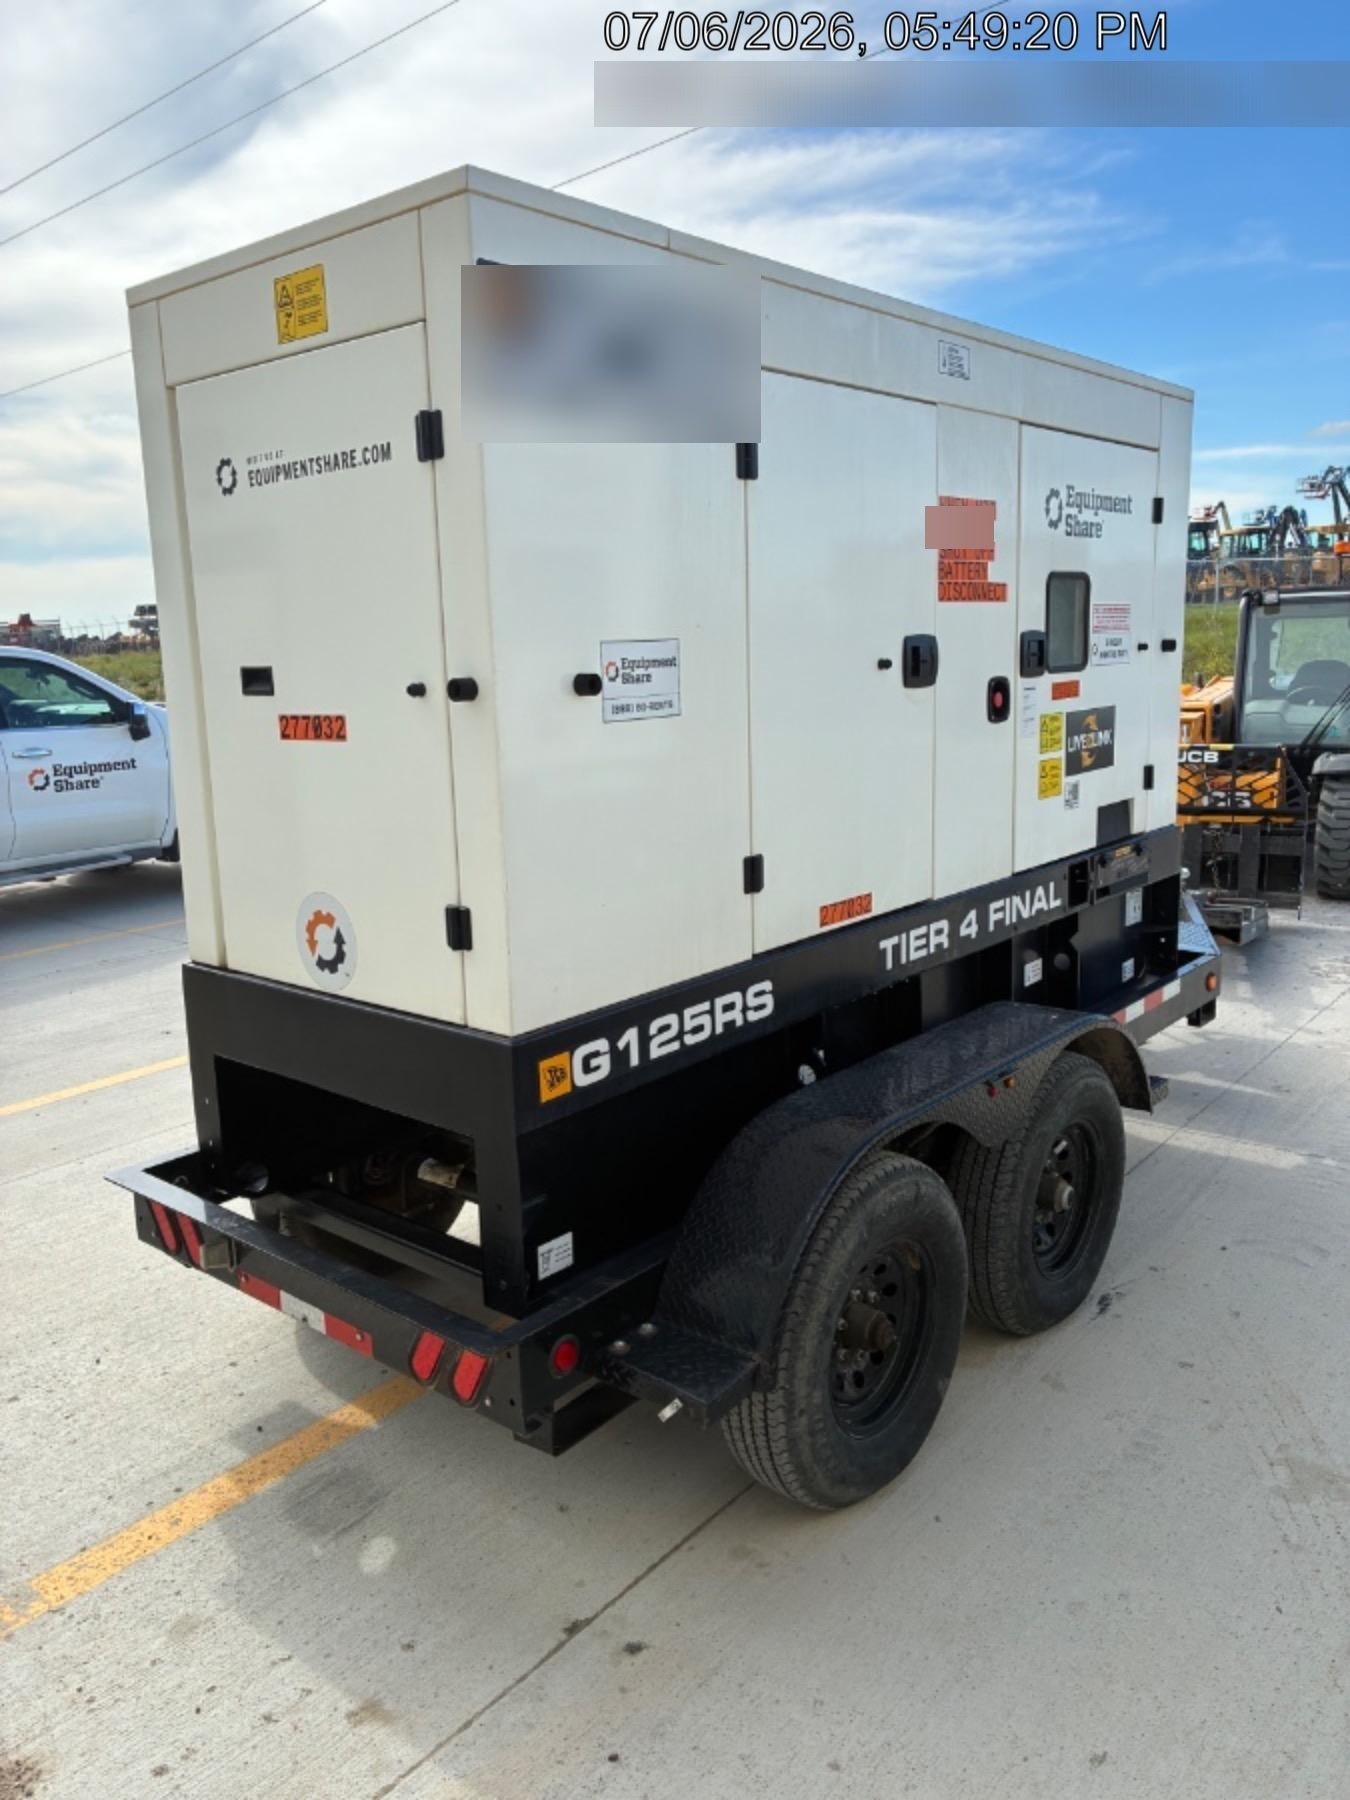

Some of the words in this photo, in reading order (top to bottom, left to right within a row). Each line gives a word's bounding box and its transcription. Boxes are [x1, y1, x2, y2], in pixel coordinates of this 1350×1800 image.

[249, 441, 392, 487] EQUIPMENTSHARE.COM
[1065, 484, 1133, 517] Equipment
[1065, 513, 1103, 538] Share
[939, 561, 988, 580] BATTERY
[939, 582, 1007, 601] DISCONNECT
[620, 656, 677, 672] Equipment
[621, 672, 652, 685] Share
[280, 715, 346, 741] 277032
[1178, 751, 1219, 763] JCB
[52, 758, 137, 778] Equipment
[53, 778, 101, 793] Share
[878, 919, 950, 971] TIER
[959, 908, 979, 940] 4
[988, 881, 1063, 933] FINAL
[572, 979, 775, 1088] G125RS
